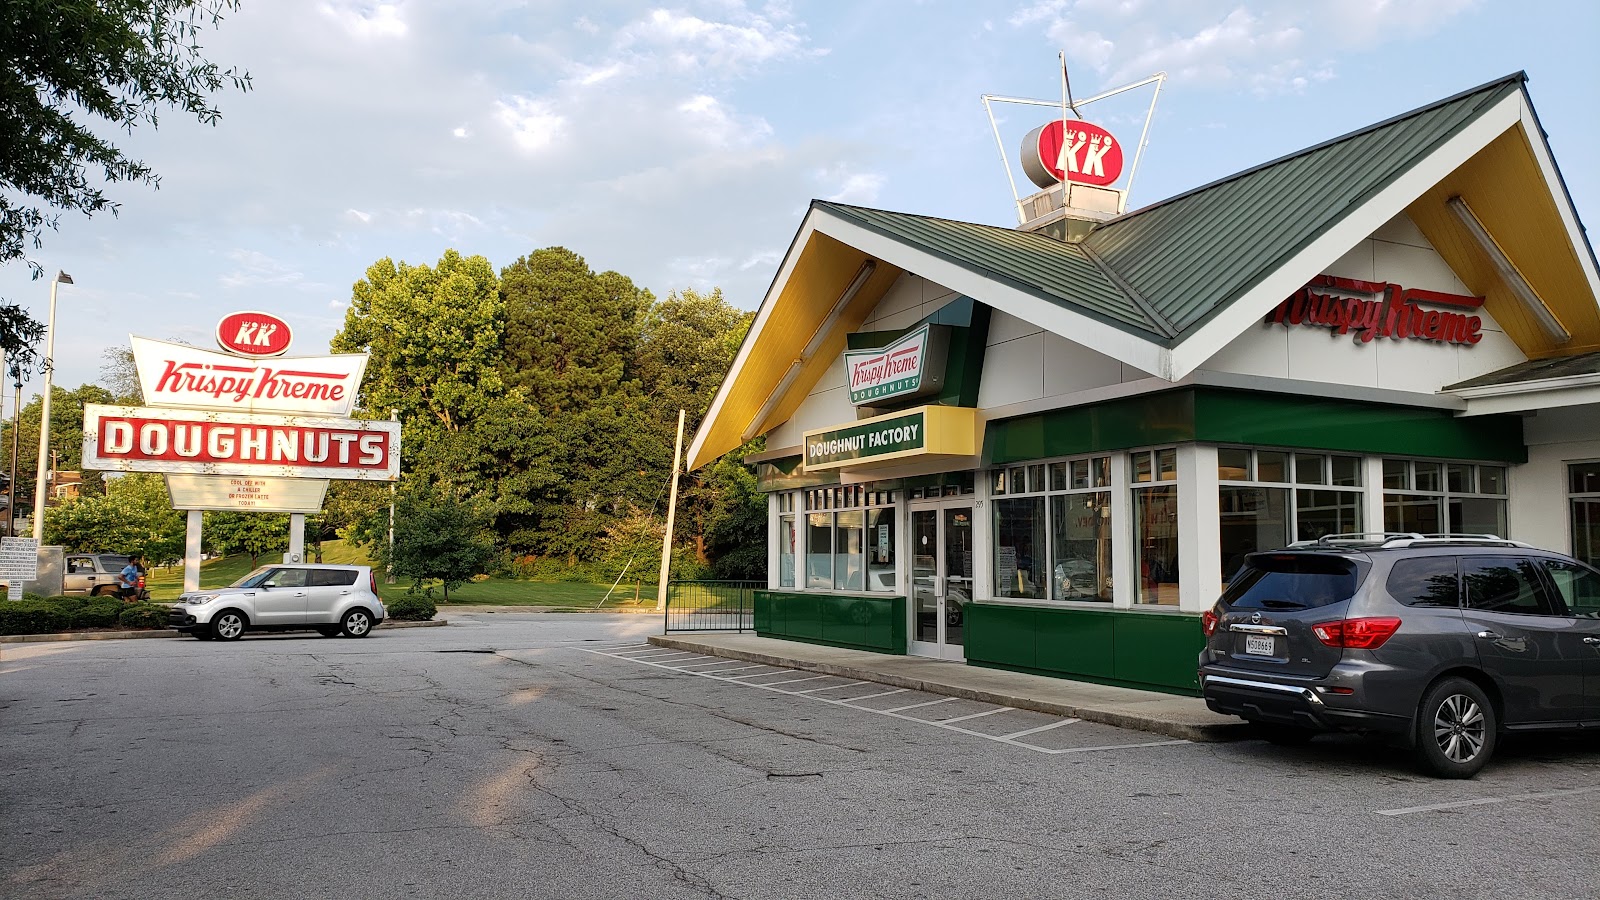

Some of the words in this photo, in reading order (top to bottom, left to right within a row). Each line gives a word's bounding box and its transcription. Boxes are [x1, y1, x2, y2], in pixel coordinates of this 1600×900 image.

[1055, 129, 1112, 177] KK
[234, 321, 277, 347] KK
[1378, 283, 1486, 345] Kreme
[155, 360, 258, 402] Krispy
[252, 367, 350, 401] Kreme
[852, 355, 885, 387] Krispy
[883, 345, 919, 379] Kreme
[103, 420, 384, 465] DOUGHNUTS
[809, 434, 865, 458] DOUGHNUT
[869, 424, 918, 448] FACTORY
